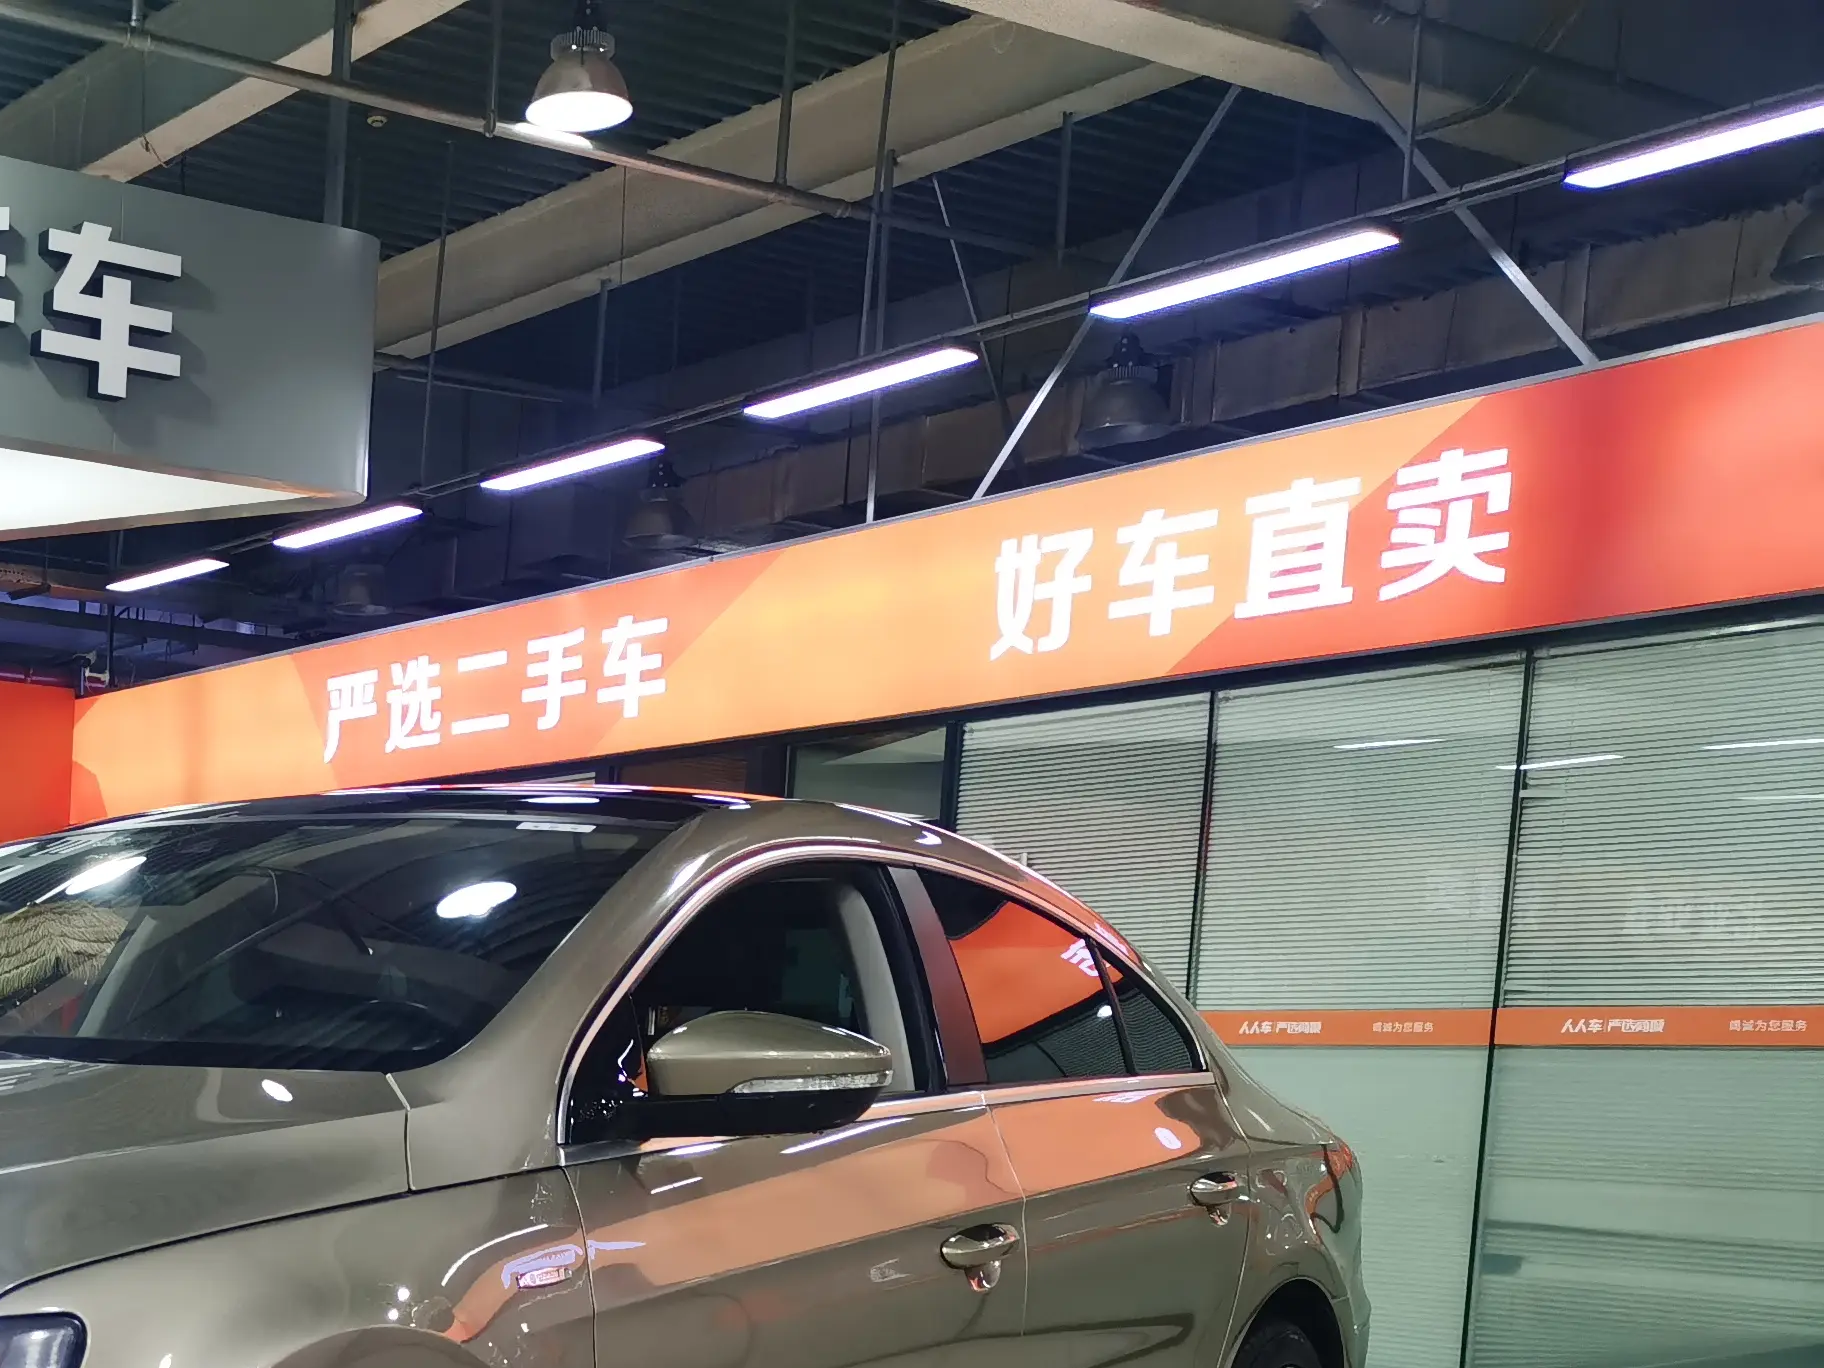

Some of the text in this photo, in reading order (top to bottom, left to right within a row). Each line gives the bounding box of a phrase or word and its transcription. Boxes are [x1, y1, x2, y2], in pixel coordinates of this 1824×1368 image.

[988, 447, 1512, 660] 好车直卖
[323, 615, 669, 764] 严选二手车
[1238, 1020, 1272, 1034] 人人车
[1561, 1019, 1604, 1033] 人人车
